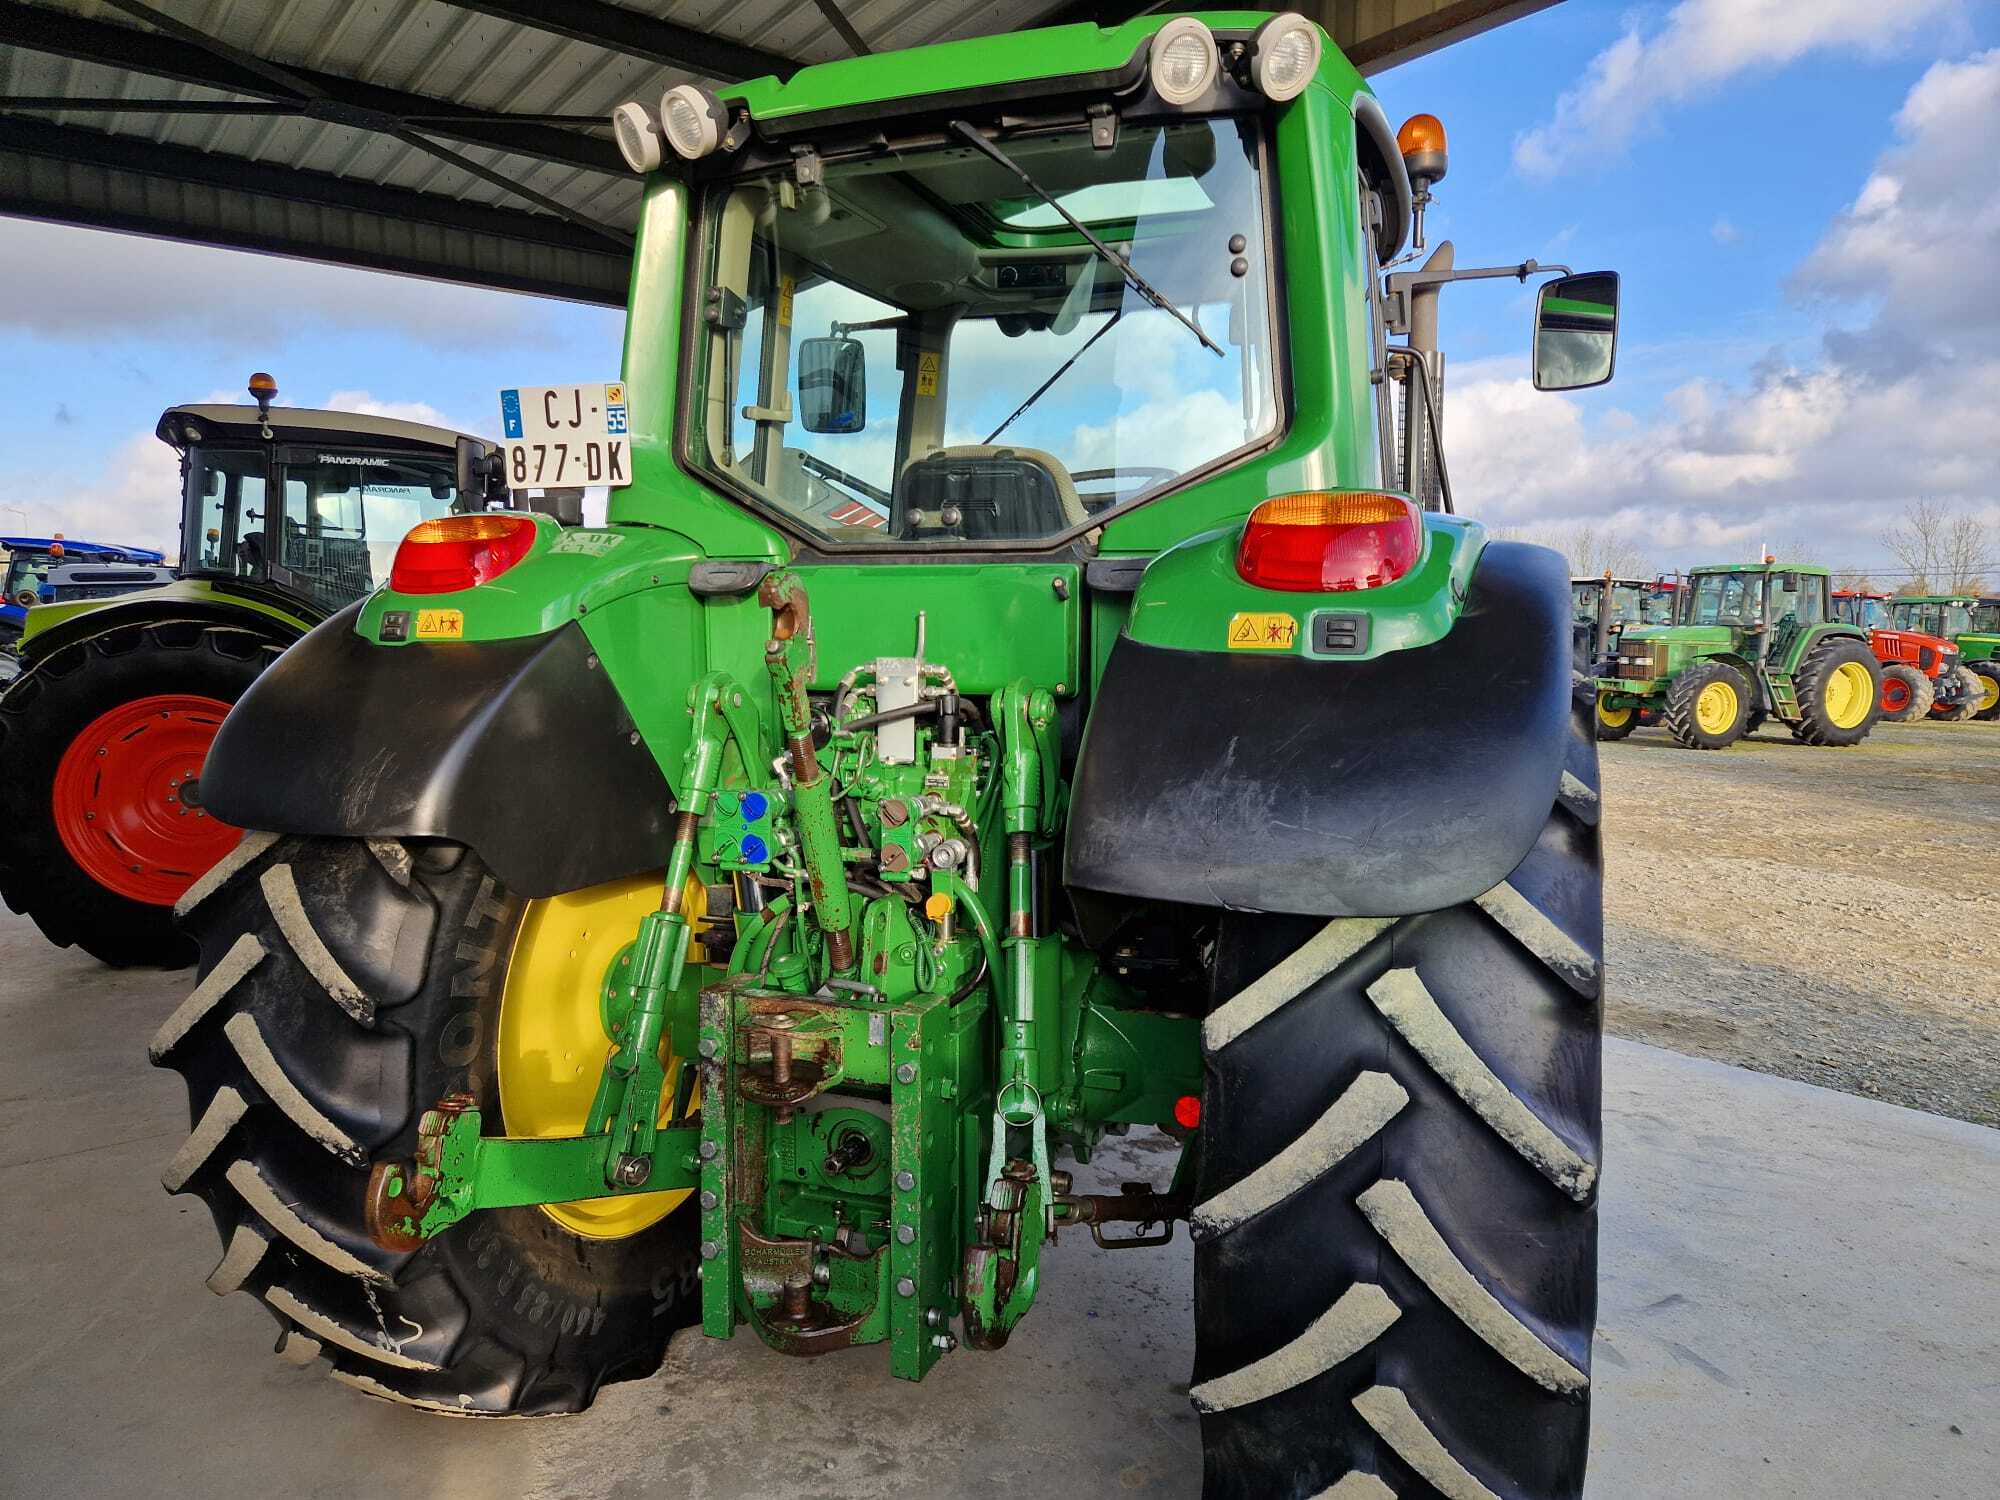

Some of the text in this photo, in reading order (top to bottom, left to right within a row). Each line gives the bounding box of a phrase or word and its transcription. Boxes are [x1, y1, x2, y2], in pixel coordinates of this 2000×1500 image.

[509, 419, 516, 431] F
[607, 409, 626, 430] 55
[319, 455, 390, 467] PANORAMIC
[512, 441, 624, 483] 877-DK
